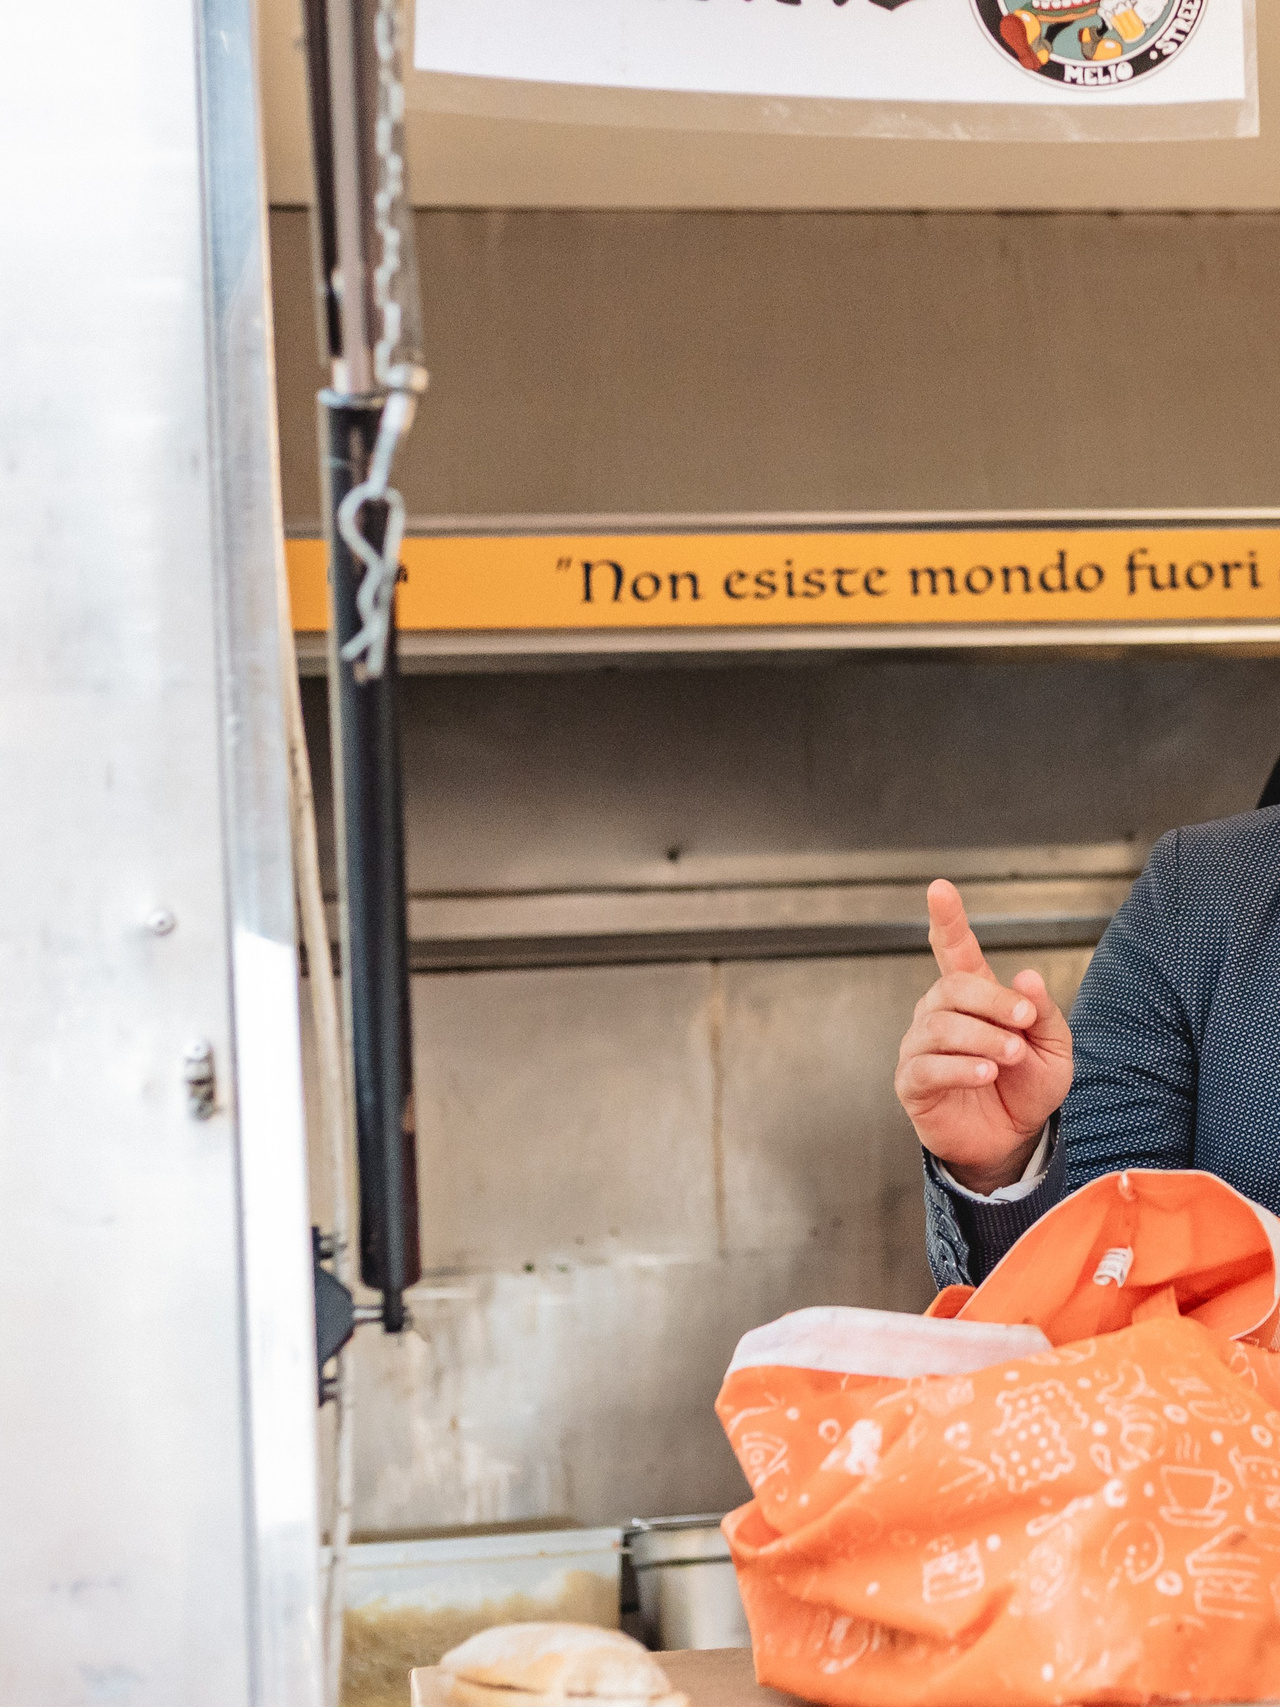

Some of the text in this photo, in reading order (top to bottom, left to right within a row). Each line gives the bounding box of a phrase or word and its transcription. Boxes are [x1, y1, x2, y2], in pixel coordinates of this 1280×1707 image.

[1155, 0, 1201, 57] STREE
[1064, 61, 1133, 85] MELIO
[722, 558, 887, 600] esiste
[909, 549, 1105, 596] mondo
[1126, 547, 1262, 596] fuori
